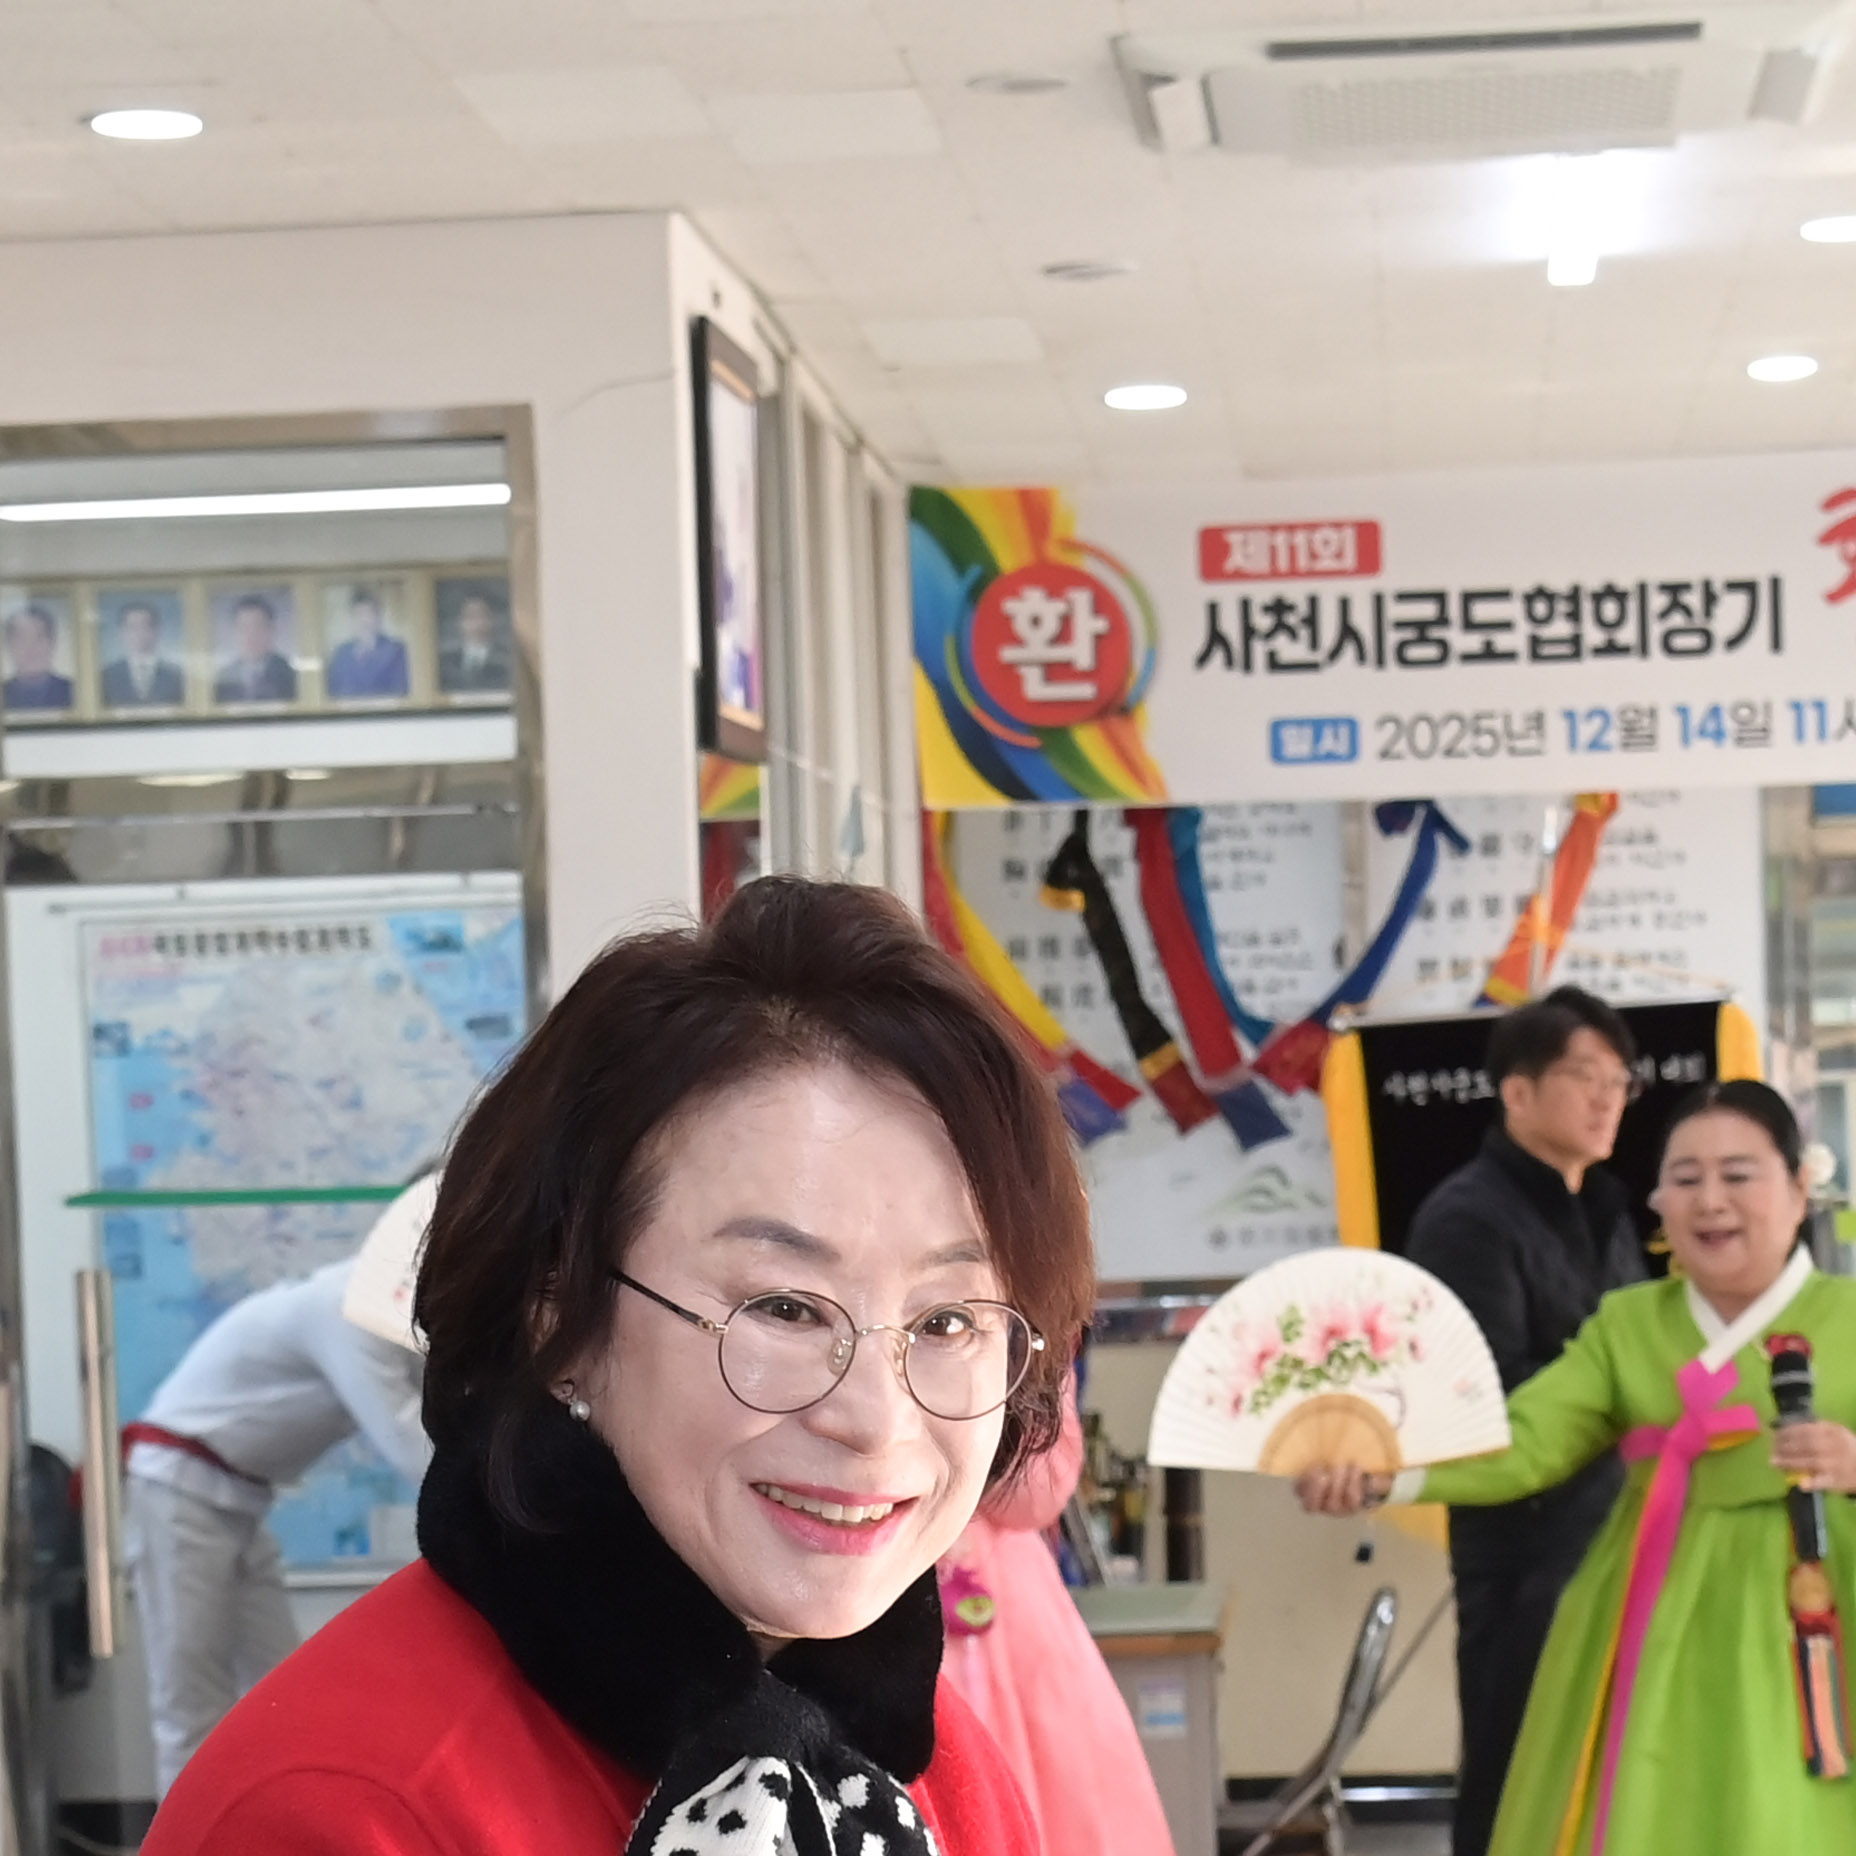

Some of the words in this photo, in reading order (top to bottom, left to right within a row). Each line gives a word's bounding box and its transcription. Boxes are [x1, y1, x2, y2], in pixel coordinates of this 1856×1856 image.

[1222, 524, 1358, 575] 제11회
[998, 585, 1111, 702] 환
[1194, 577, 1783, 674] 사천시궁도협회장기
[1282, 722, 1350, 759] 일시
[1375, 710, 1544, 760] 2025년
[1563, 703, 1658, 753] 12월
[1675, 700, 1772, 748] 14일
